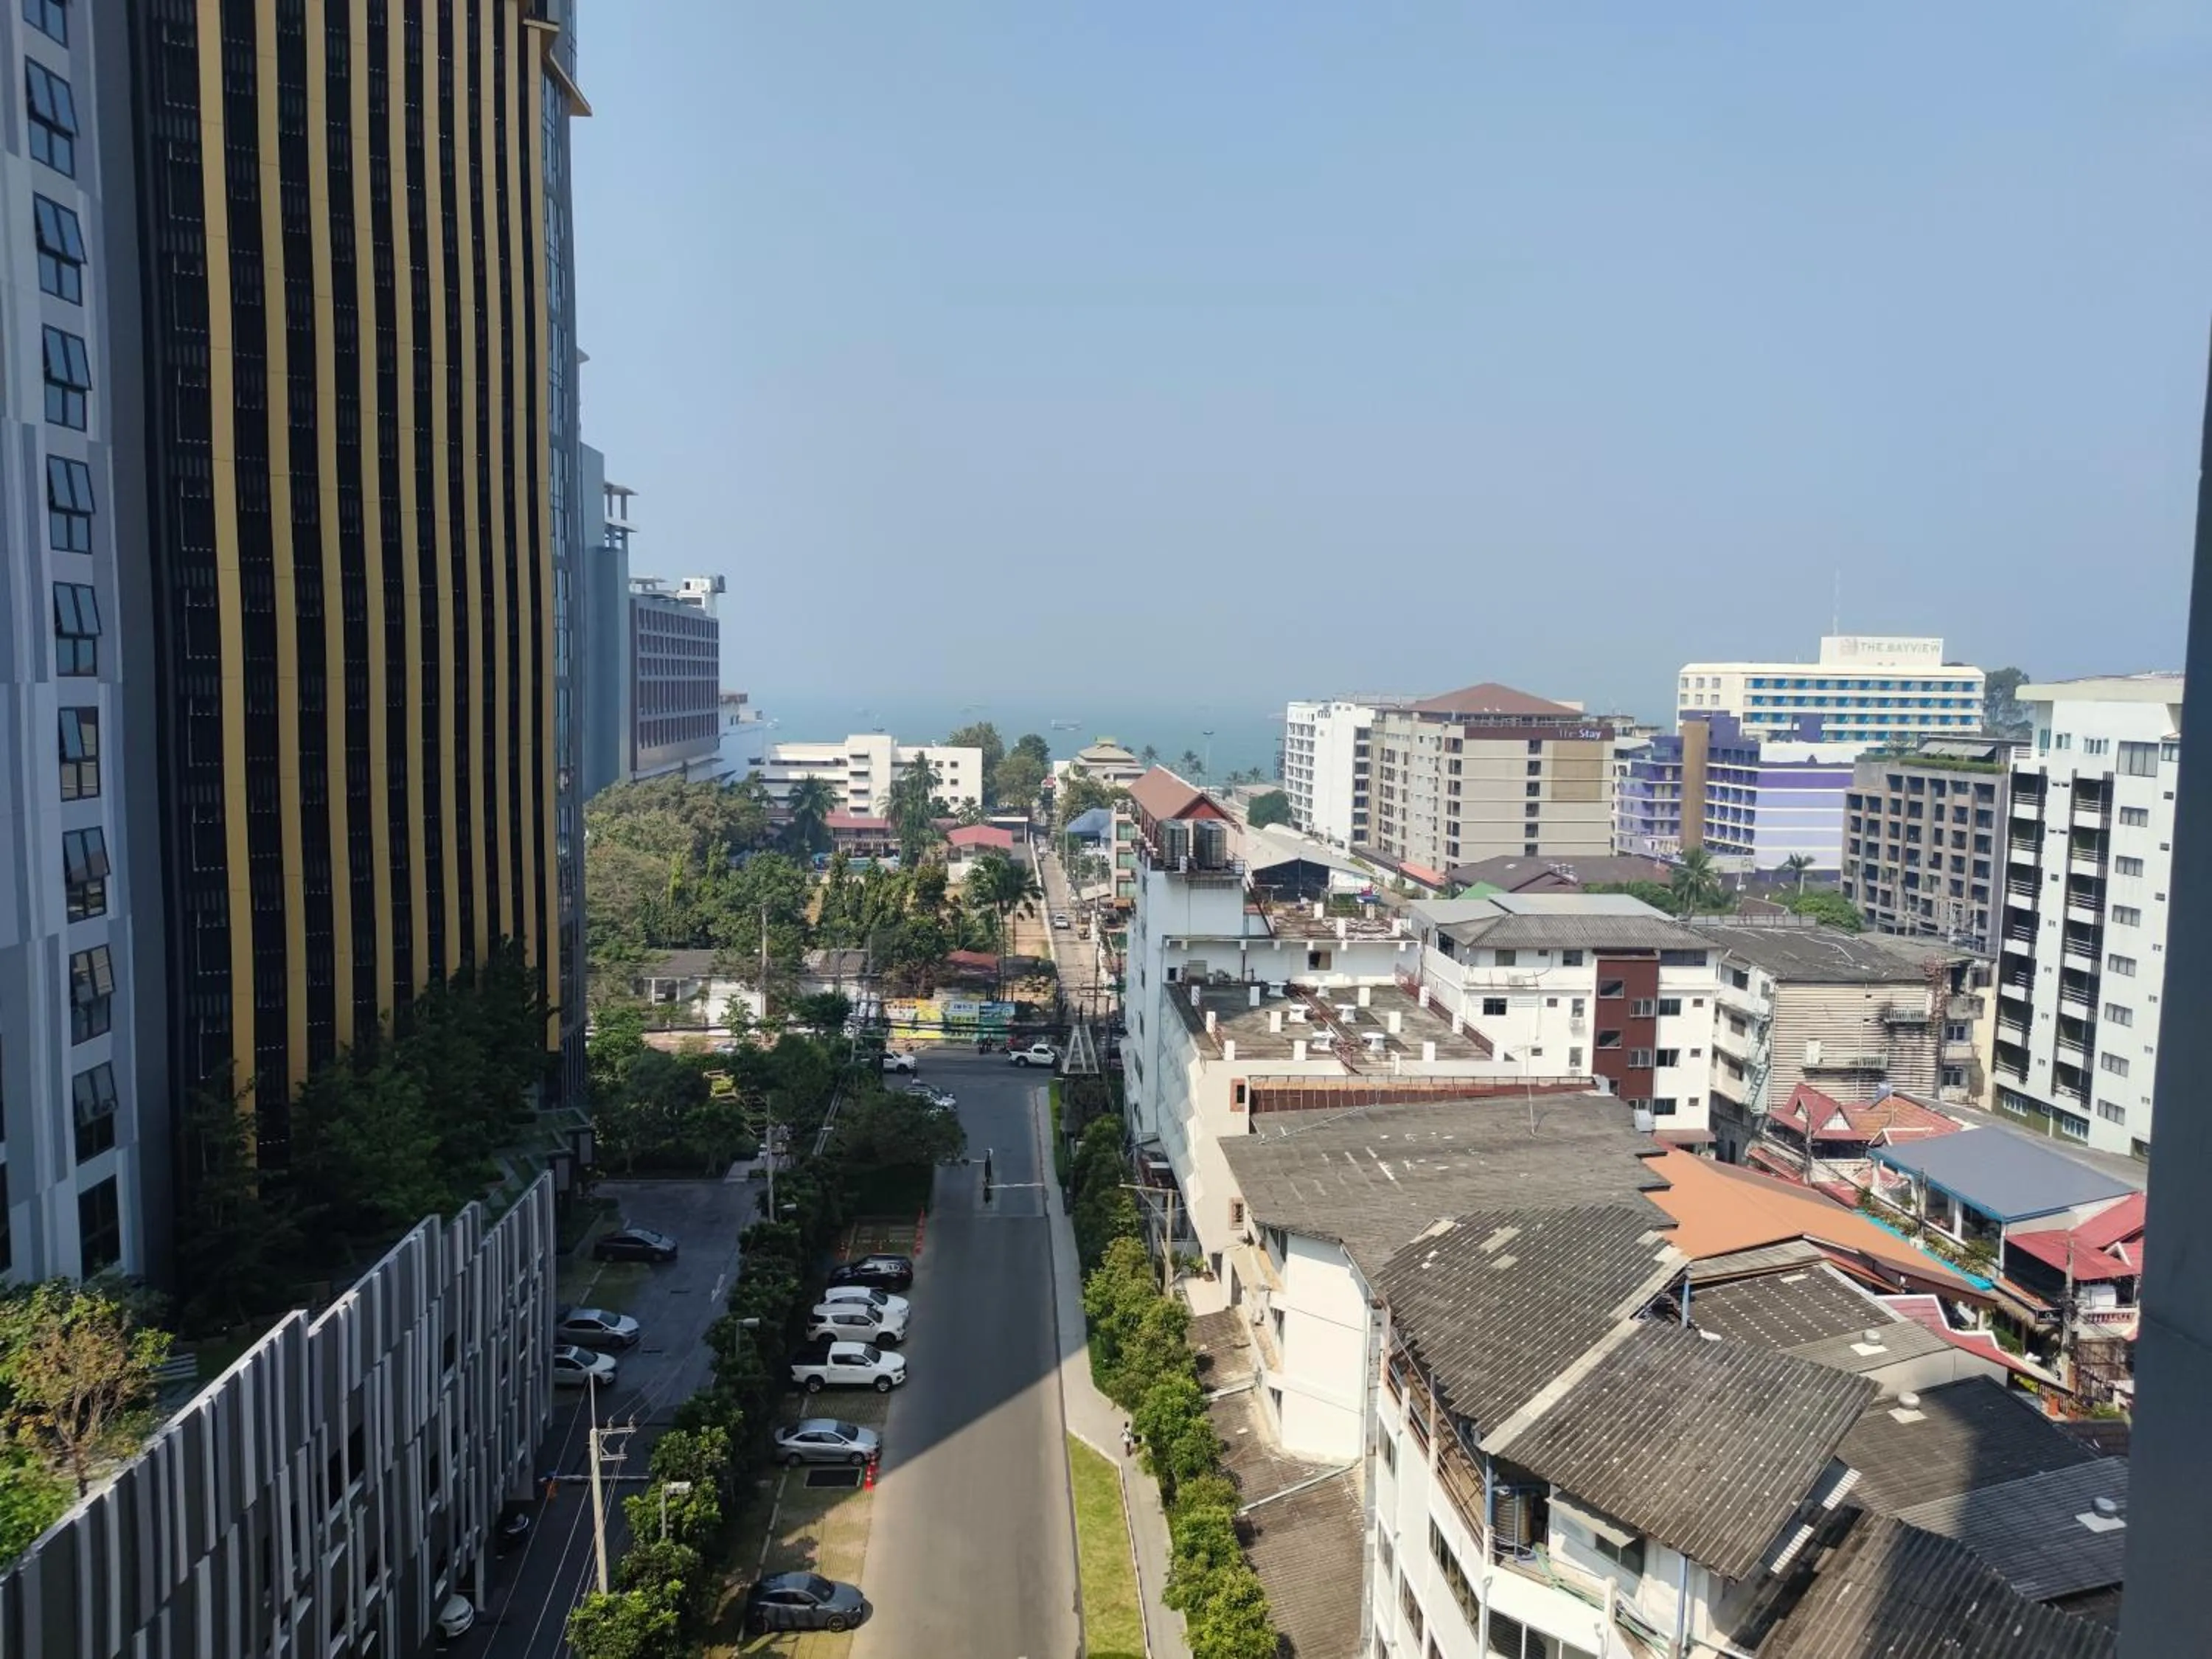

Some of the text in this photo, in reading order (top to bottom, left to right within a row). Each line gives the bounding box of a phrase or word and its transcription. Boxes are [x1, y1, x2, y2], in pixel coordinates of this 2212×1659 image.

[1860, 641, 1939, 654] THE BAYVIEW
[1579, 728, 1601, 740] Stay
